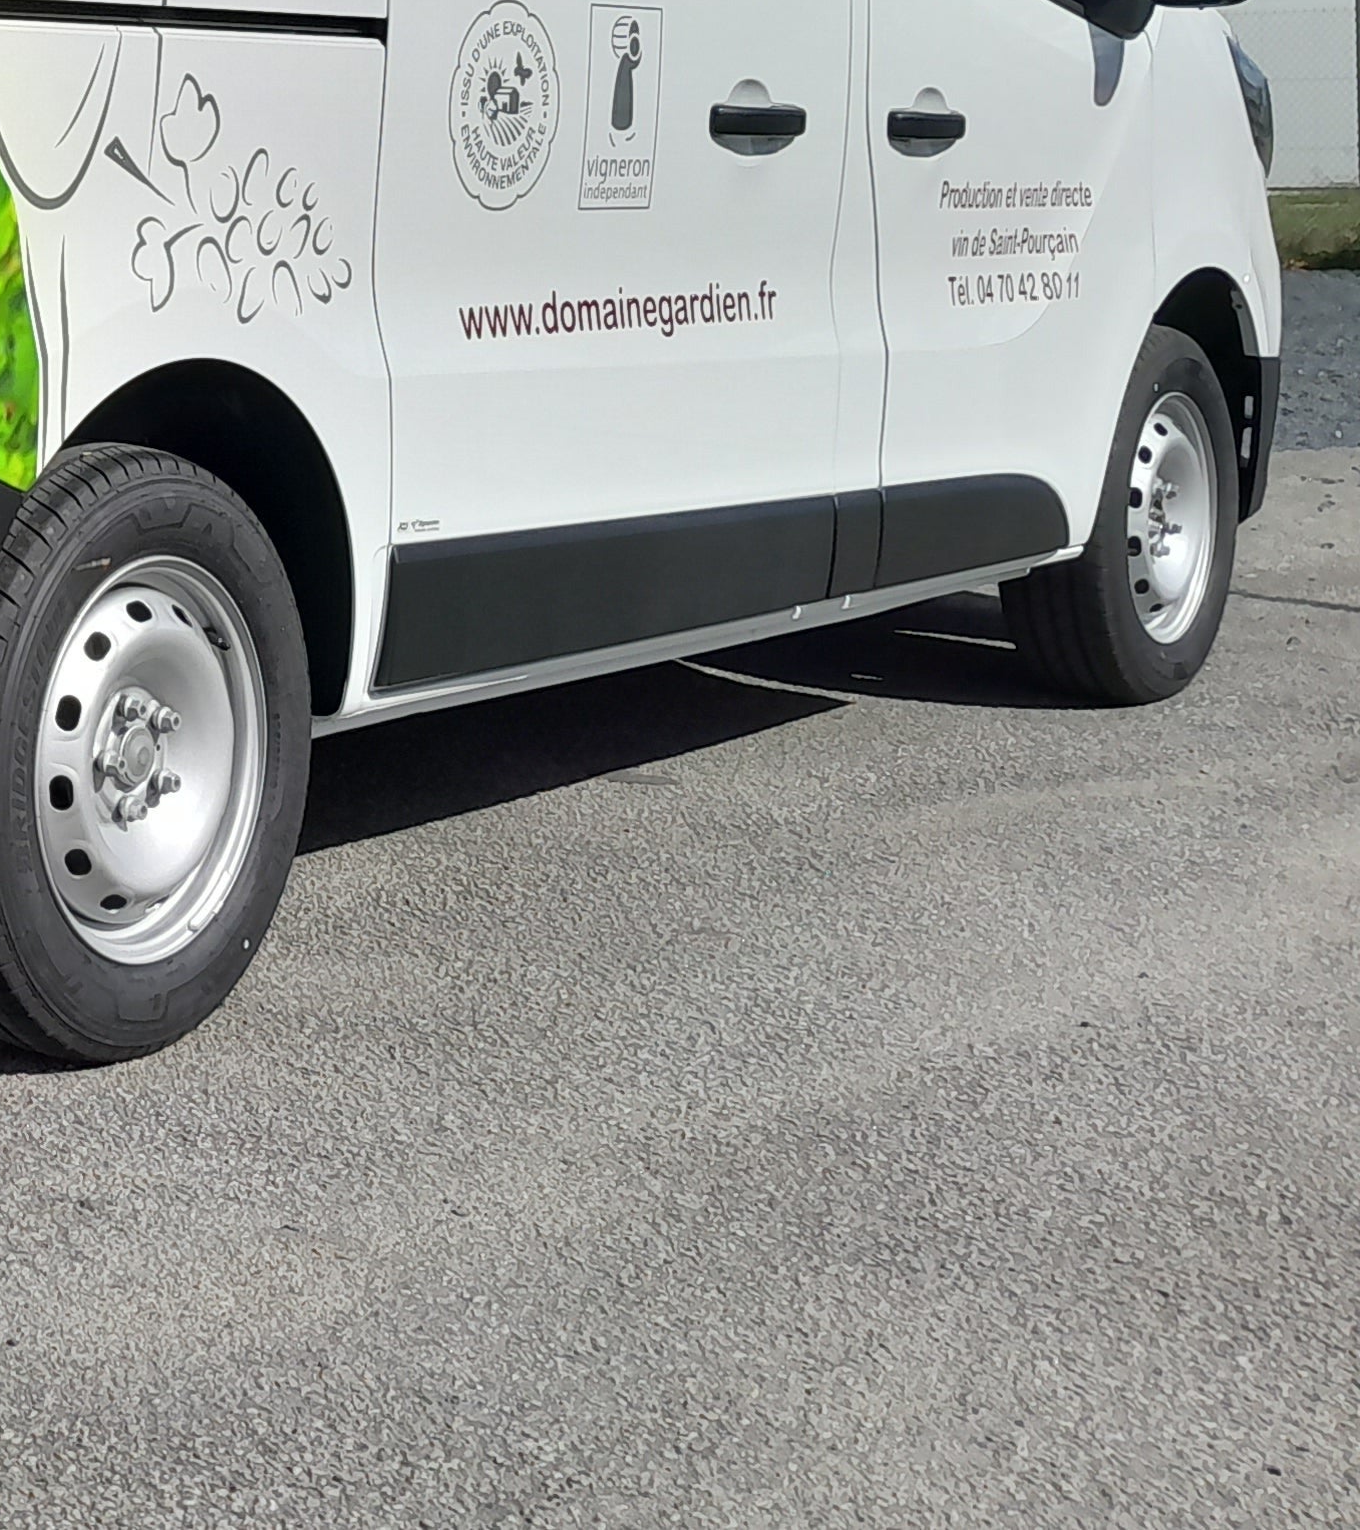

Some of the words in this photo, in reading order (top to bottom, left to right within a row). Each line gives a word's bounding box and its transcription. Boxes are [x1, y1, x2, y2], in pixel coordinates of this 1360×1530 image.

[461, 64, 475, 106] ISSU
[471, 22, 501, 61] D'UNE
[503, 21, 550, 107] EXPLOITATION
[461, 123, 547, 190] ENVIRONNEMENTALE
[471, 123, 498, 170] HAUTE
[500, 126, 536, 172] VALEUR
[587, 155, 650, 185] vigneron
[939, 180, 1003, 209] Production
[1005, 182, 1018, 208] et
[1020, 182, 1049, 208] vente
[1050, 180, 1093, 208] directe
[952, 229, 969, 257] vin
[971, 229, 987, 257] de
[988, 227, 1079, 261] Saint-Pourçain
[948, 275, 975, 306] Tél.
[977, 274, 994, 304] 04
[997, 273, 1015, 303] 70
[1040, 271, 1063, 300] 80
[1066, 271, 1080, 299] 11
[459, 280, 777, 340] www.domainegardien.fr
